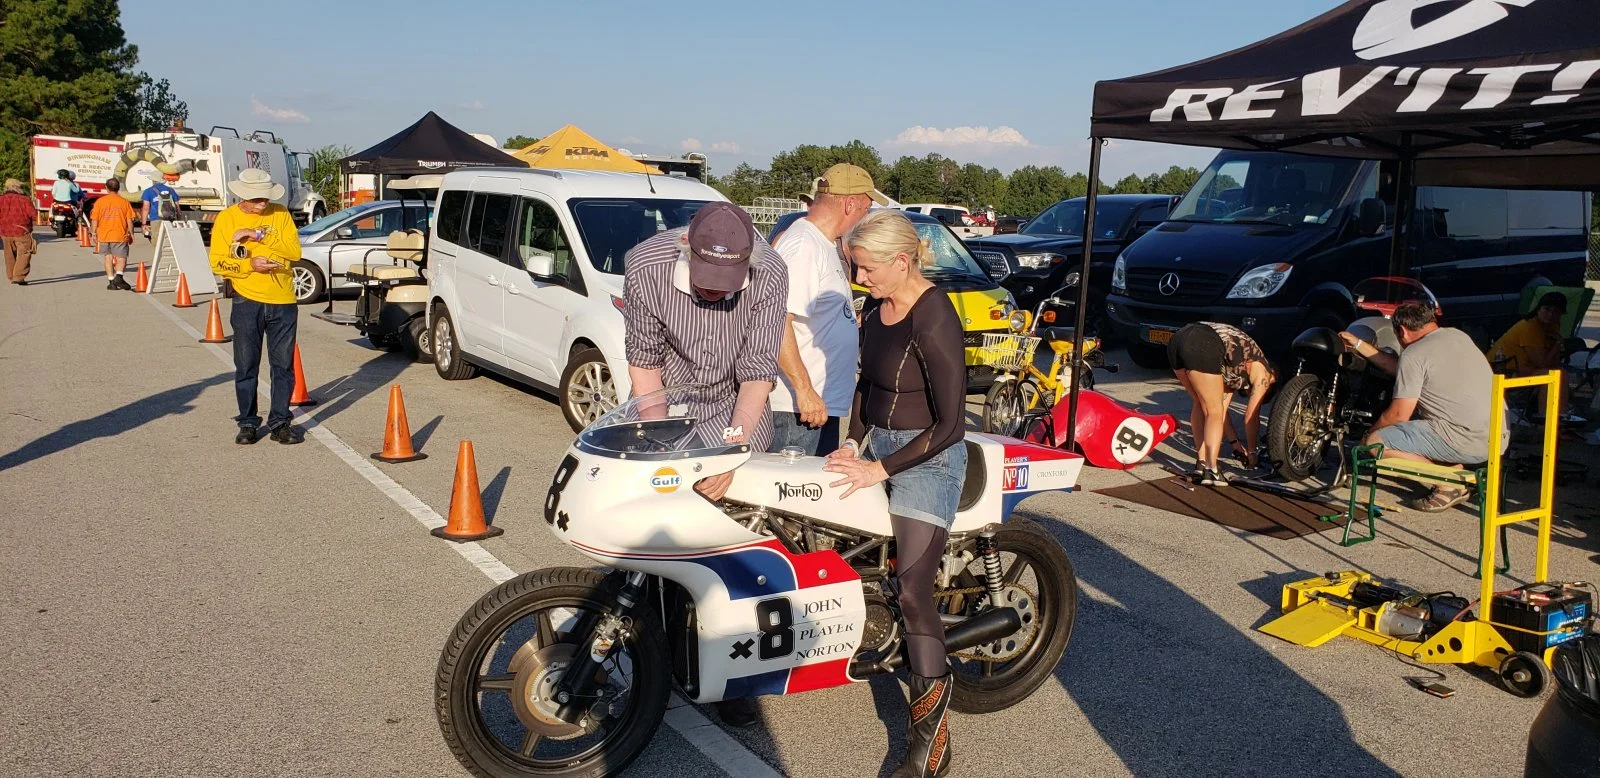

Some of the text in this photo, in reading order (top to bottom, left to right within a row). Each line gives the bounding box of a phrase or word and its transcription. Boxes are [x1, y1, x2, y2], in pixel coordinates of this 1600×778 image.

[67, 154, 111, 164] BIRMINGHAM
[565, 147, 608, 157] KTM
[1117, 426, 1148, 451] 8
[651, 476, 681, 487] Gulf
[775, 481, 822, 501] Norton
[802, 597, 843, 618] JOHN
[755, 596, 795, 661] 8
[799, 623, 854, 640] PLAYER
[795, 641, 856, 660] NORTON
